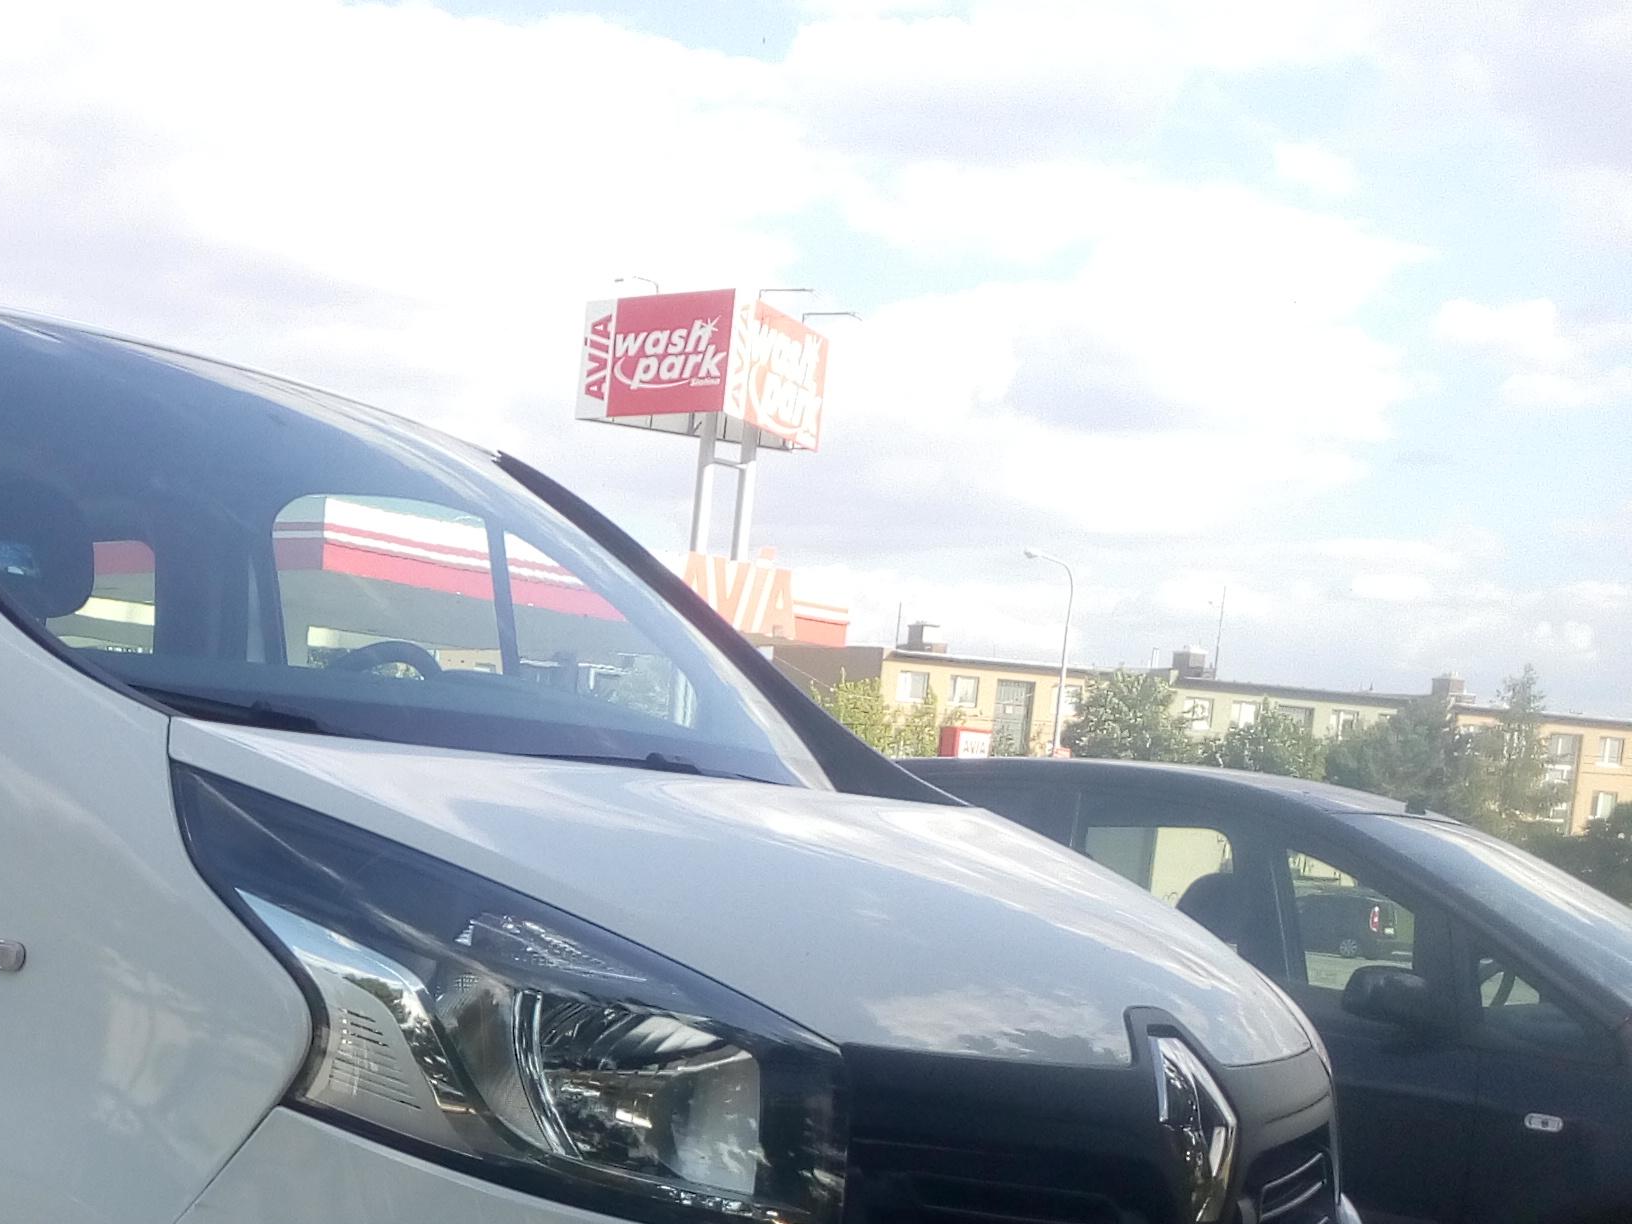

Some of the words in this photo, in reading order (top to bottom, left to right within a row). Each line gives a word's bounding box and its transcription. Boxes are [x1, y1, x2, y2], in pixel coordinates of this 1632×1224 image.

[585, 314, 613, 401] AVIA
[615, 319, 714, 358] wash
[630, 344, 727, 390] park
[680, 547, 797, 640] AVIA
